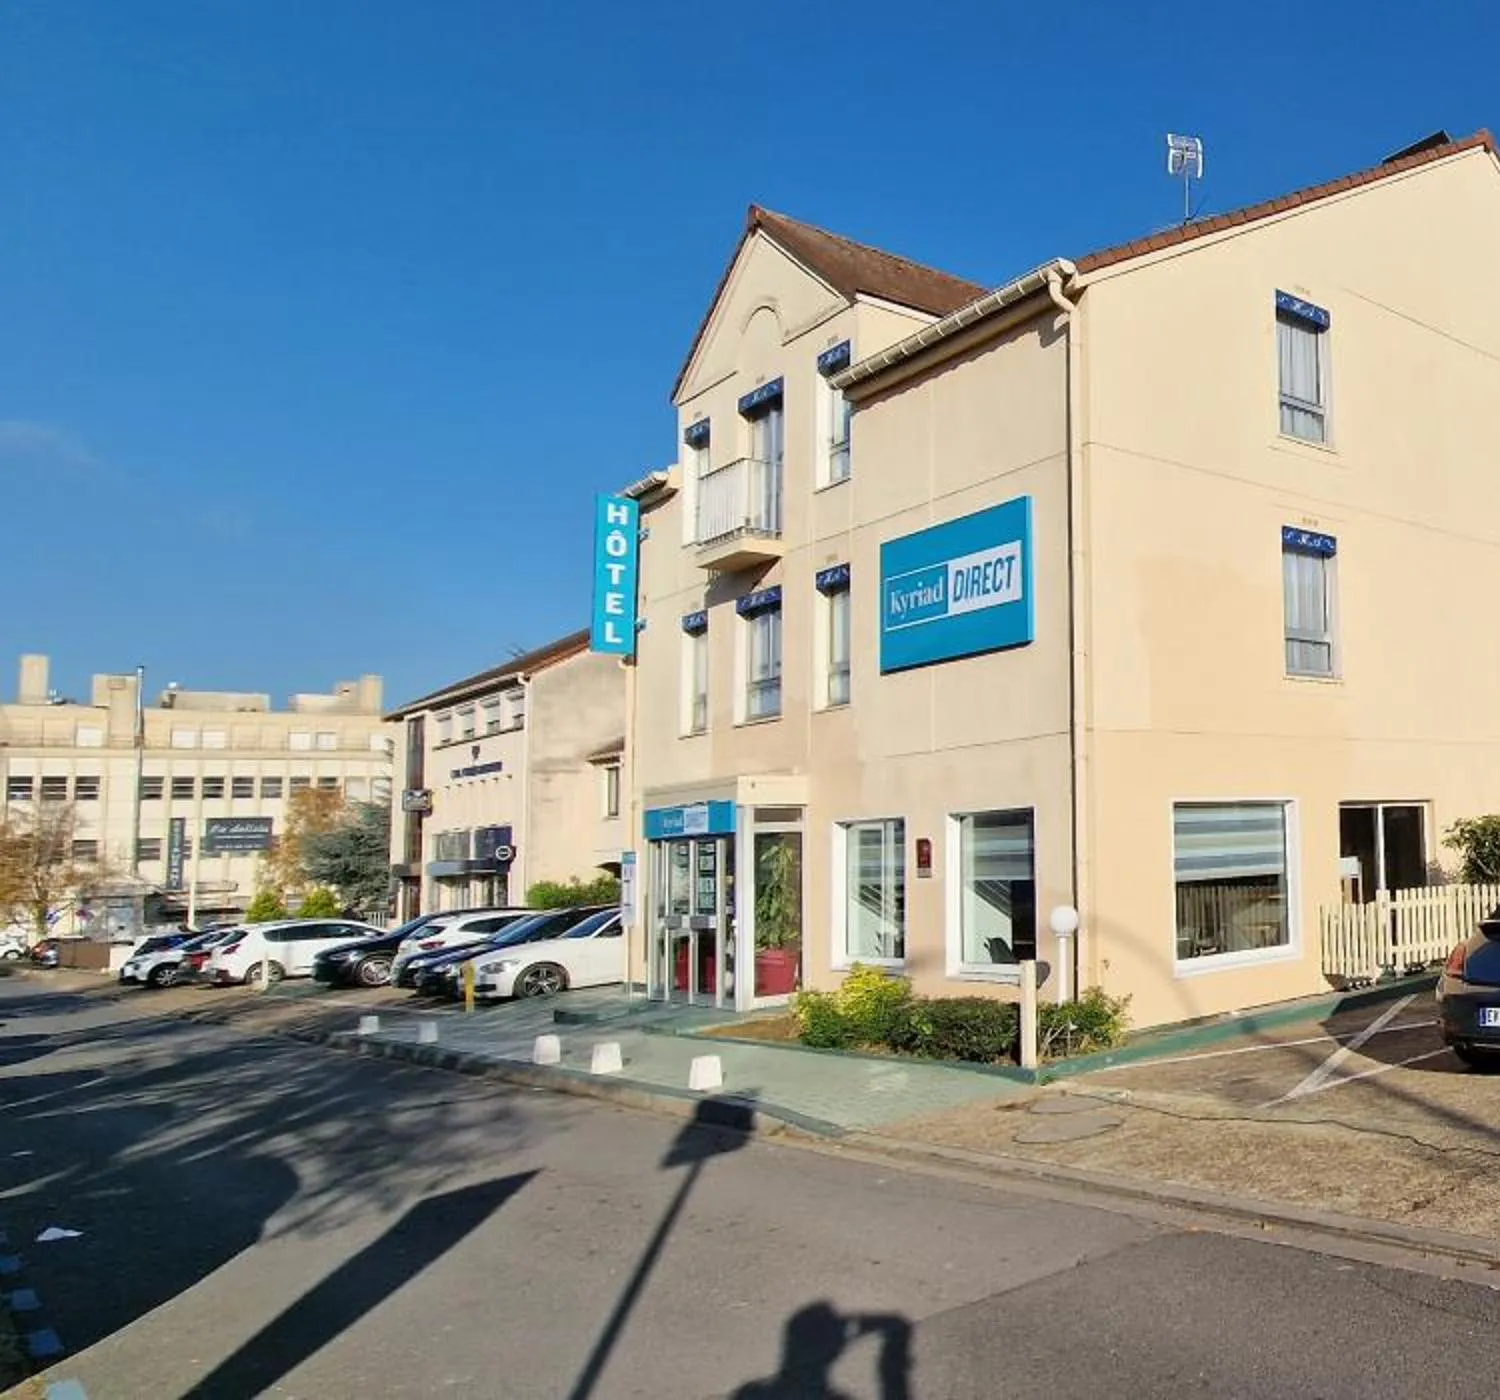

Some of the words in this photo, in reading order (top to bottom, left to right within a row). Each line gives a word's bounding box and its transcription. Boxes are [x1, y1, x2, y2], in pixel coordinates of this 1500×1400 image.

[605, 503, 629, 644] HÔTEL
[891, 576, 944, 619] Kyriad
[953, 555, 1016, 602] DIRECT
